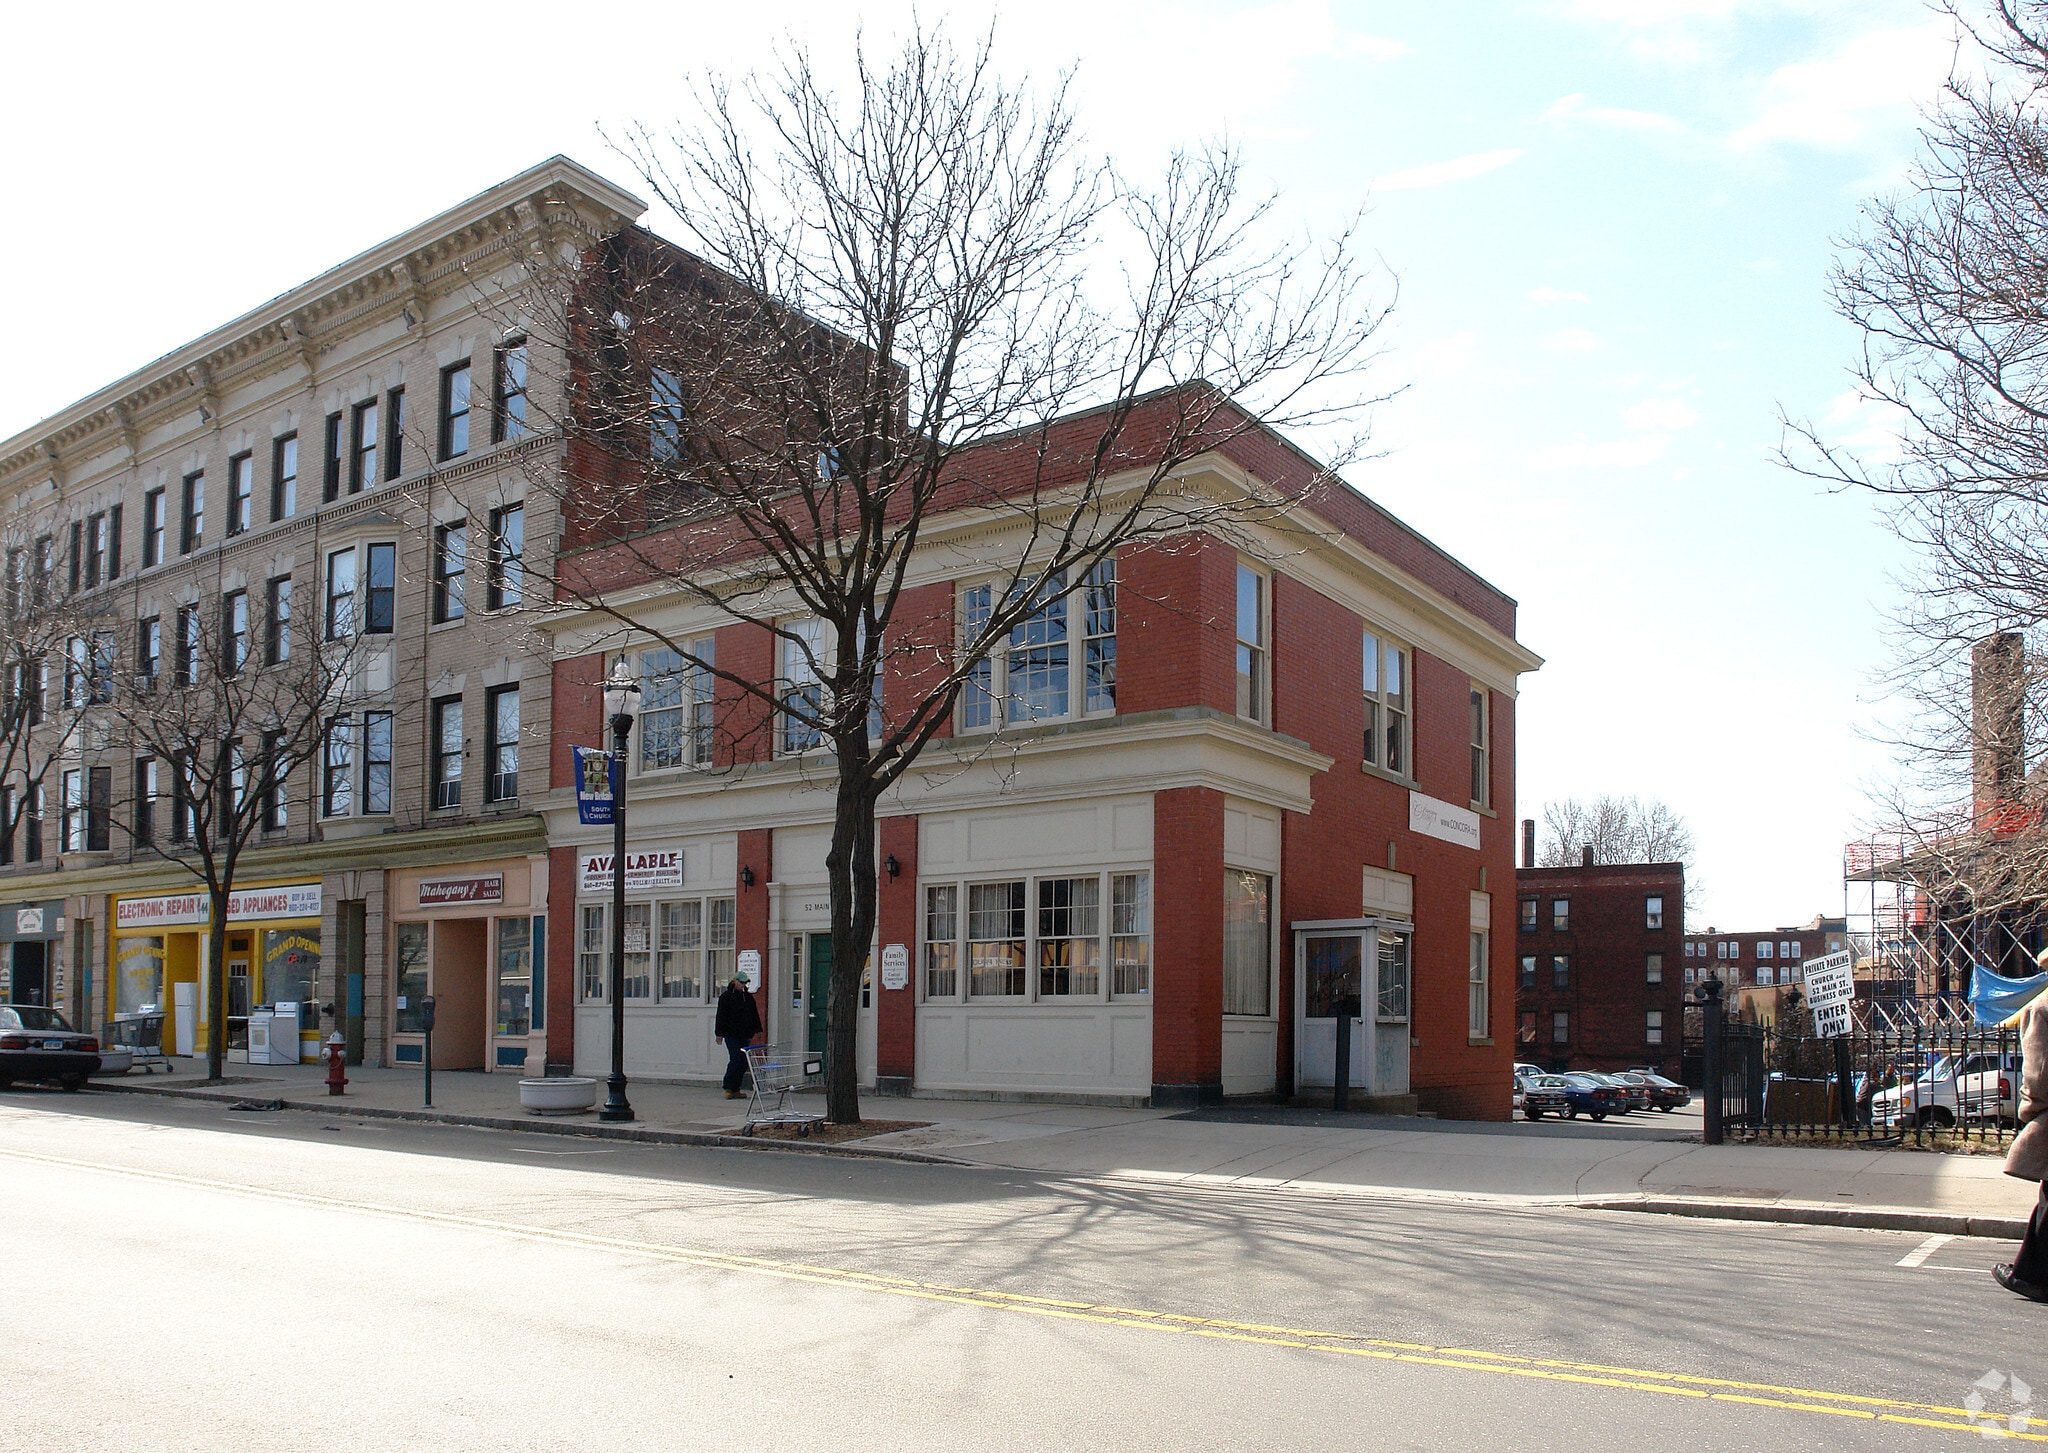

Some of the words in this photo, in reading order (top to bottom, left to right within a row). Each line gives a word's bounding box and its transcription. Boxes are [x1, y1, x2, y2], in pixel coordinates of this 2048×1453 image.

[587, 853, 678, 872] AVALABLE
[420, 884, 469, 900] Mahogany
[119, 901, 164, 920] ELECTRONIC
[166, 898, 194, 915] REPAIR
[226, 898, 241, 914] SED
[243, 894, 288, 913] APPLIANCES
[266, 936, 295, 963] GRAND
[296, 936, 321, 956] OPENIN
[885, 951, 903, 960] Family
[1805, 961, 1825, 975] PRIVATE
[1826, 954, 1849, 969] PARKING
[1811, 973, 1834, 986] CHURCH
[1812, 987, 1820, 996] 52
[1822, 982, 1837, 993] MAIN
[1839, 980, 1848, 988] ST.
[1810, 991, 1837, 1004] BUSINESS
[1838, 987, 1853, 997] ONLY
[1817, 1004, 1847, 1021] ENTER
[1822, 1018, 1846, 1034] ONLY
